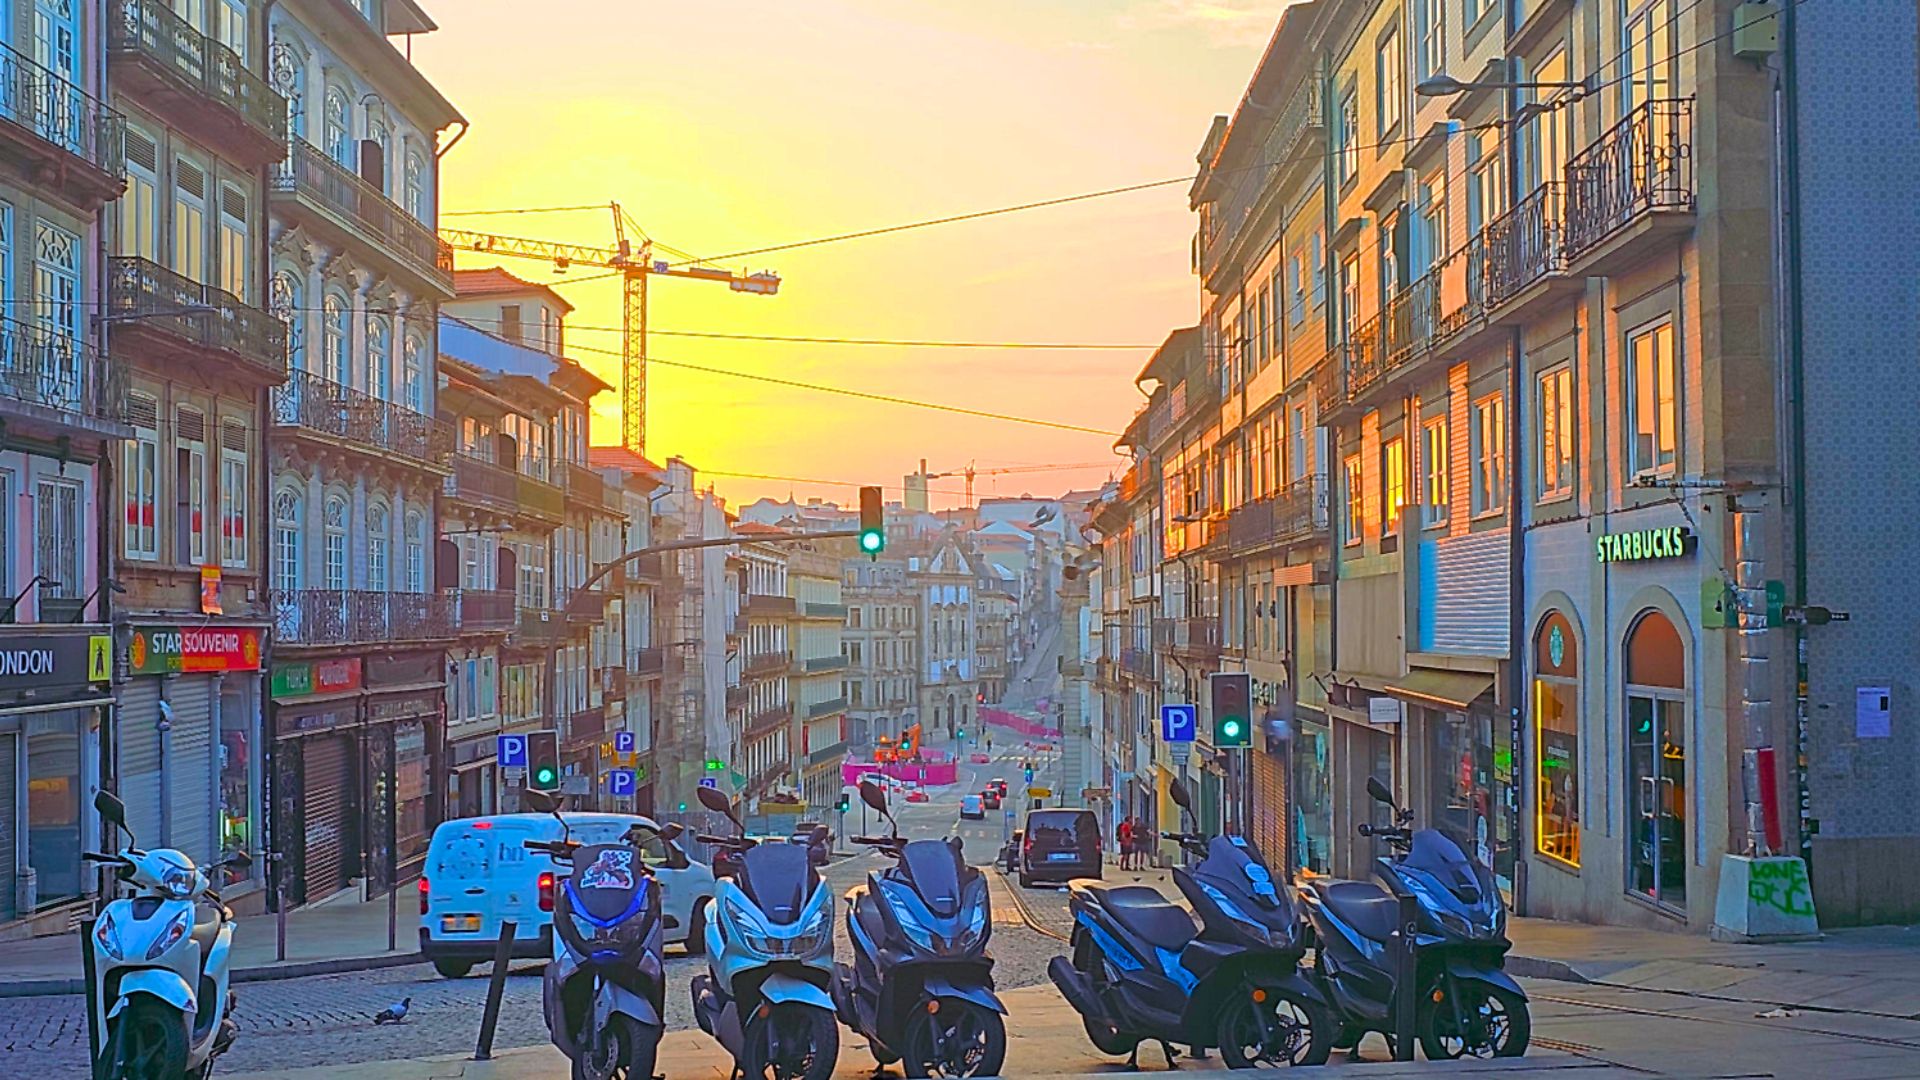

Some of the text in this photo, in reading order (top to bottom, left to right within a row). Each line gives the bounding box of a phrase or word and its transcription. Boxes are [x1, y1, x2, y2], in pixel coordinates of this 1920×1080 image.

[1597, 526, 1684, 563] STARBUCKS
[152, 632, 239, 654] STAR SOUVENIR
[1168, 709, 1188, 739] P
[504, 738, 522, 764] P
[620, 733, 632, 750] P
[614, 772, 631, 794] P
